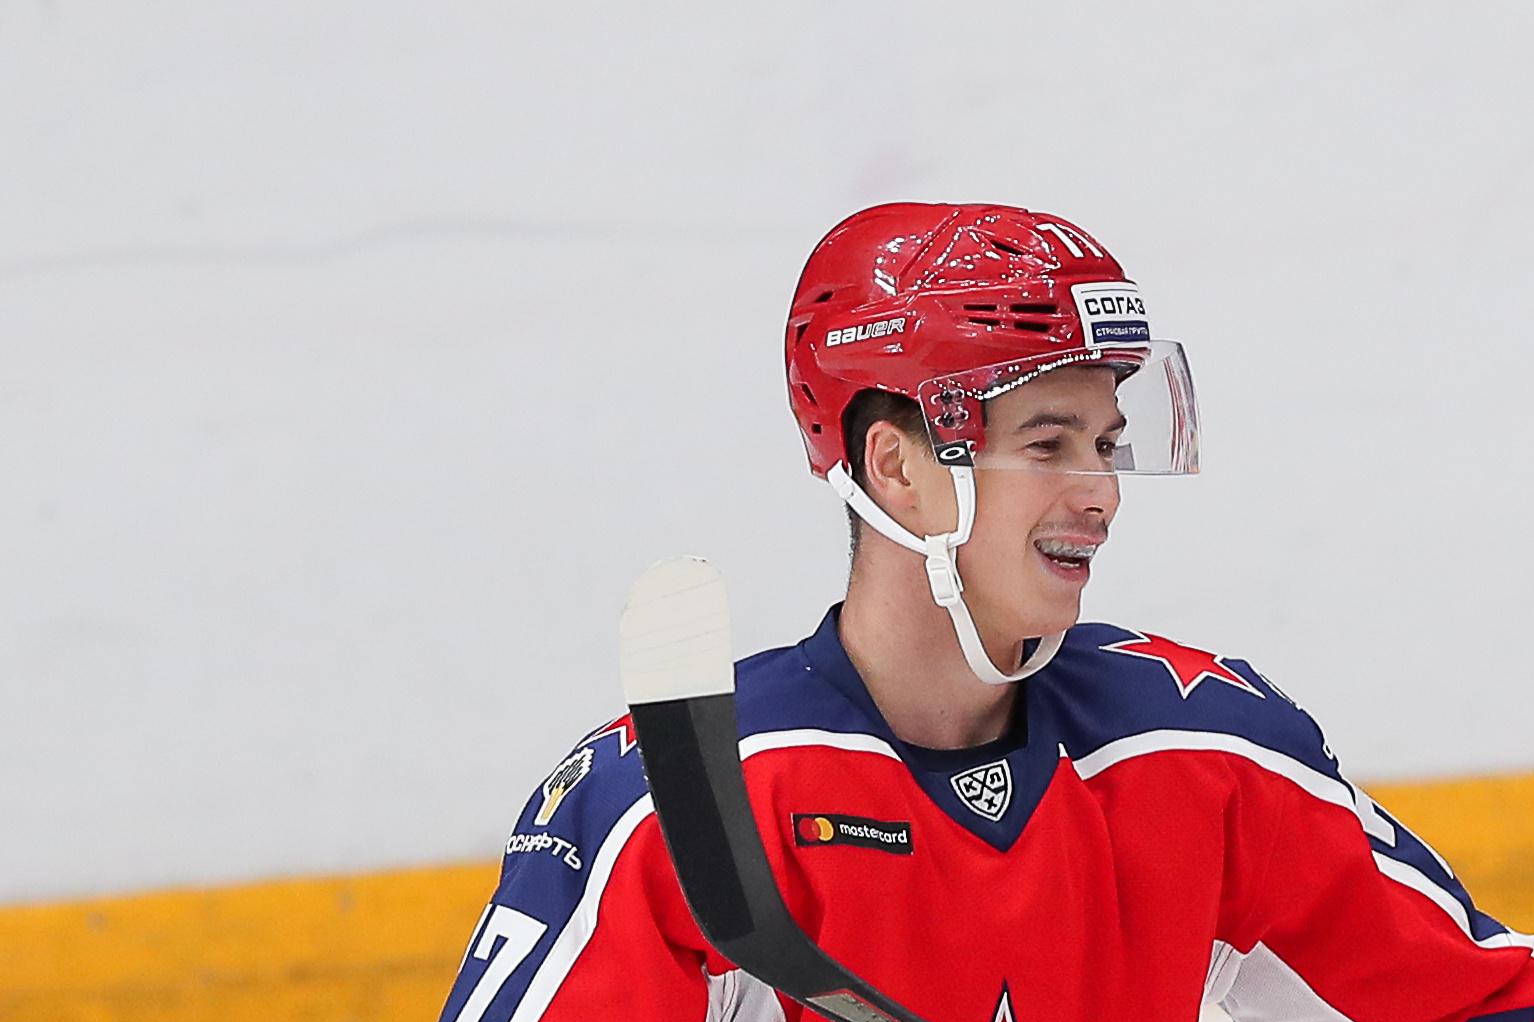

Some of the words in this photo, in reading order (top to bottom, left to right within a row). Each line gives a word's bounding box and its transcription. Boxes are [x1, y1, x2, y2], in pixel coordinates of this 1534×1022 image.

[1085, 297, 1146, 315] СОГАЗ
[826, 316, 906, 348] BAUER
[840, 823, 908, 844] mastecard
